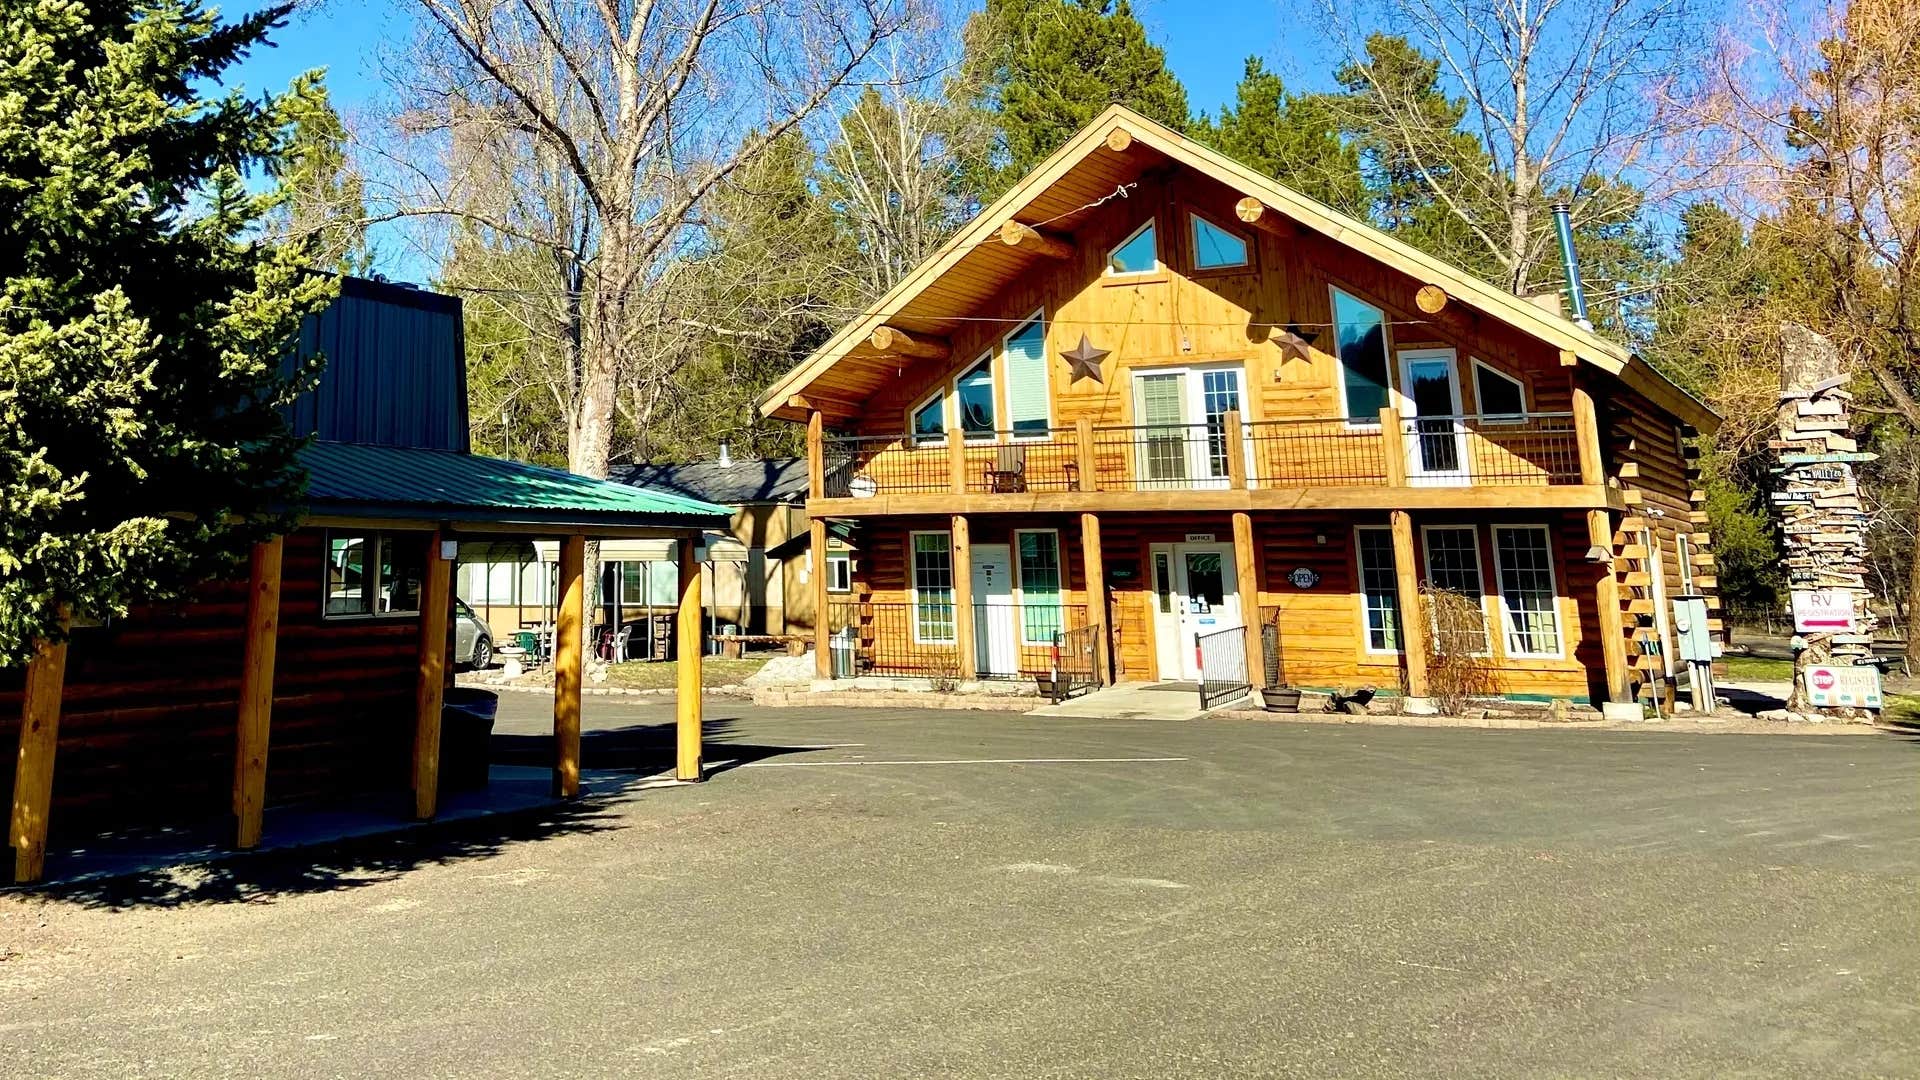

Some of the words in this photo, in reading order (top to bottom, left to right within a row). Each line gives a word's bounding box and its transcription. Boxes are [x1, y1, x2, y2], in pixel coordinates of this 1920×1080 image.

[1294, 573, 1313, 583] OPEN
[1811, 594, 1832, 607] RV
[1798, 608, 1850, 617] REGISTRATION
[1814, 675, 1833, 685] STOP
